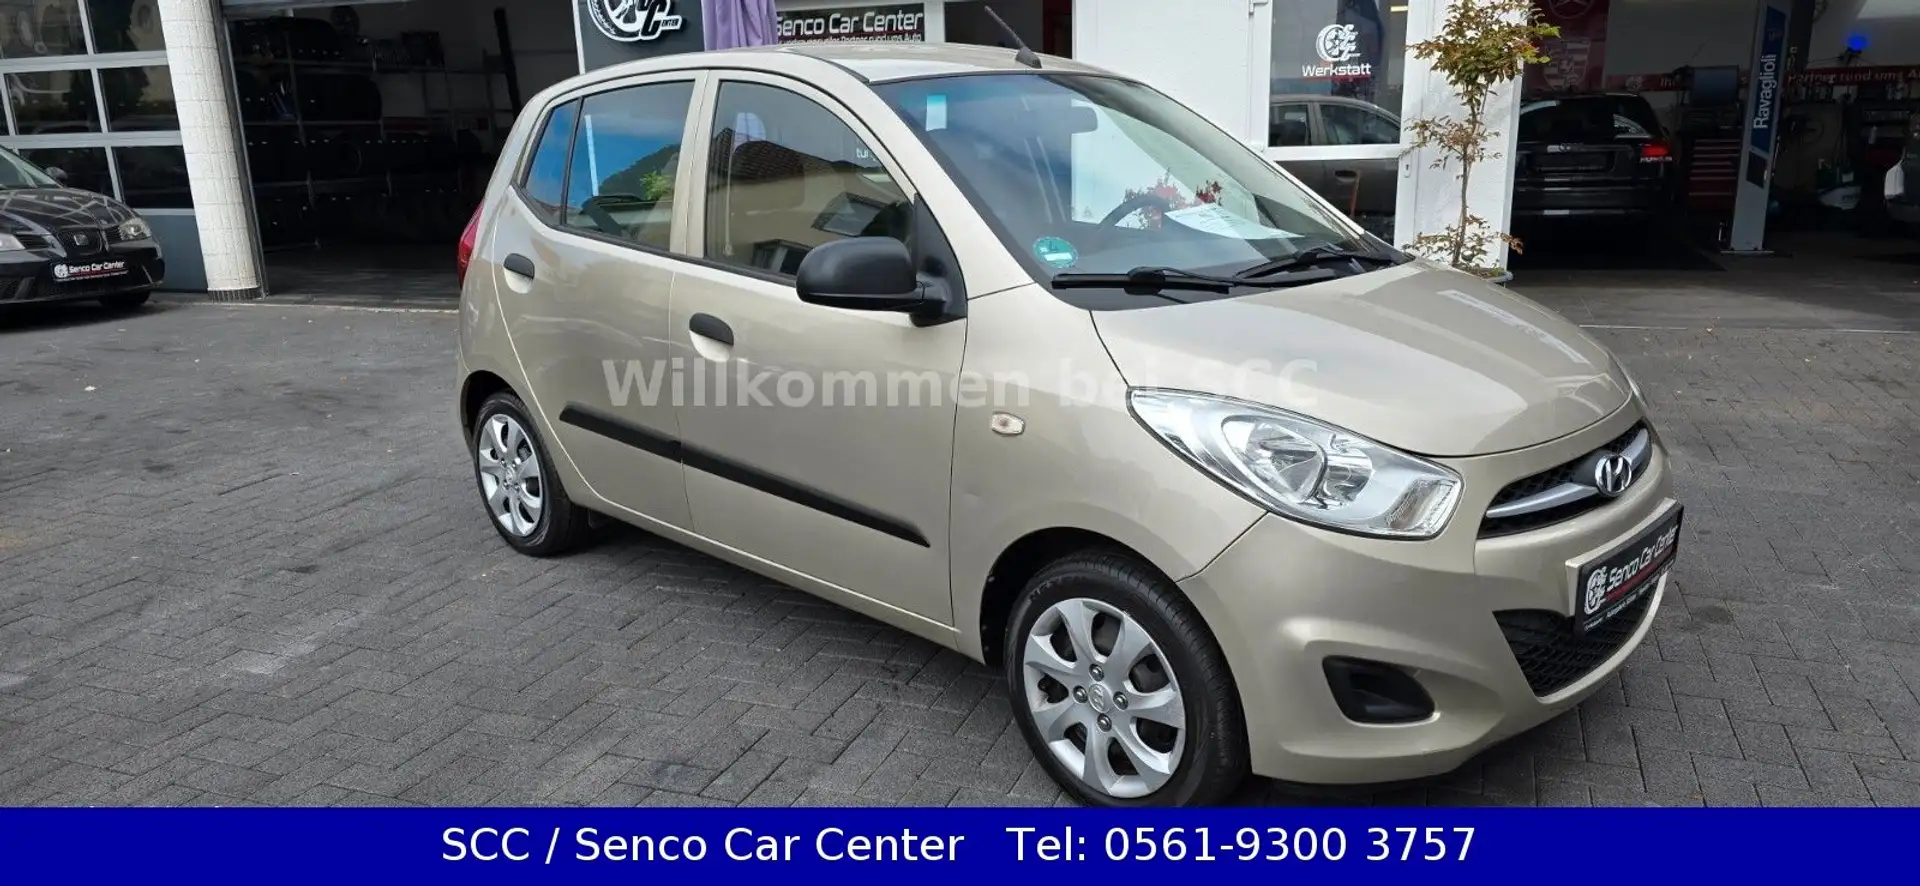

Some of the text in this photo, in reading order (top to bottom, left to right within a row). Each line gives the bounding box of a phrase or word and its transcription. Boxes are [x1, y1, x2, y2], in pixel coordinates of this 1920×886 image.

[829, 12, 859, 34] Car
[863, 10, 923, 32] Center
[1301, 63, 1371, 77] Werkstatt
[1753, 54, 1777, 129] Ravaglioli
[91, 263, 103, 271] Car
[1606, 524, 1680, 593] Senco Car Center
